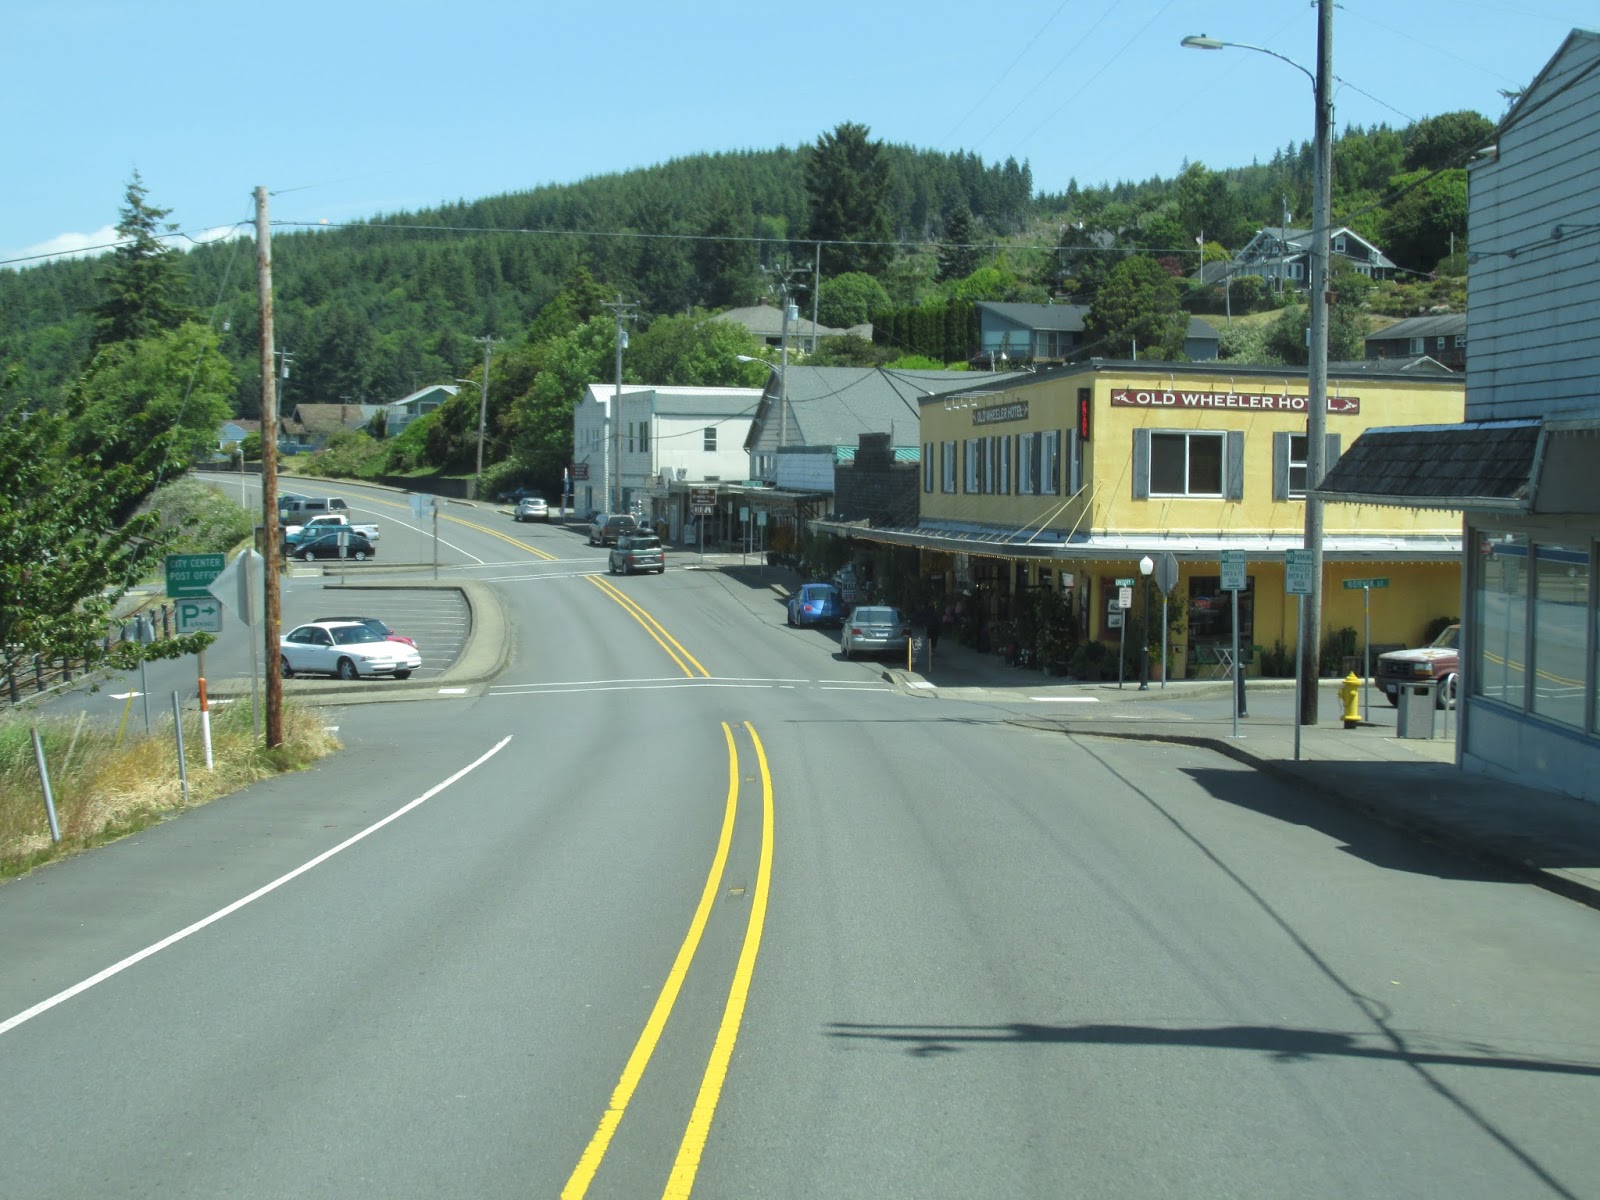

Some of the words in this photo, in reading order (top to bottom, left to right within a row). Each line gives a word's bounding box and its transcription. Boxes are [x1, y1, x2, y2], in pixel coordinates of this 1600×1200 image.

[1136, 392, 1176, 406] OLD
[1181, 392, 1274, 409] WHEELER
[1278, 397, 1338, 411] HOL
[976, 411, 986, 422] OLD
[986, 407, 1007, 421] WHEELER
[1007, 405, 1023, 419] HOTEL
[170, 559, 187, 568] CITY
[190, 558, 220, 568] CENTER
[169, 571, 190, 581] POST
